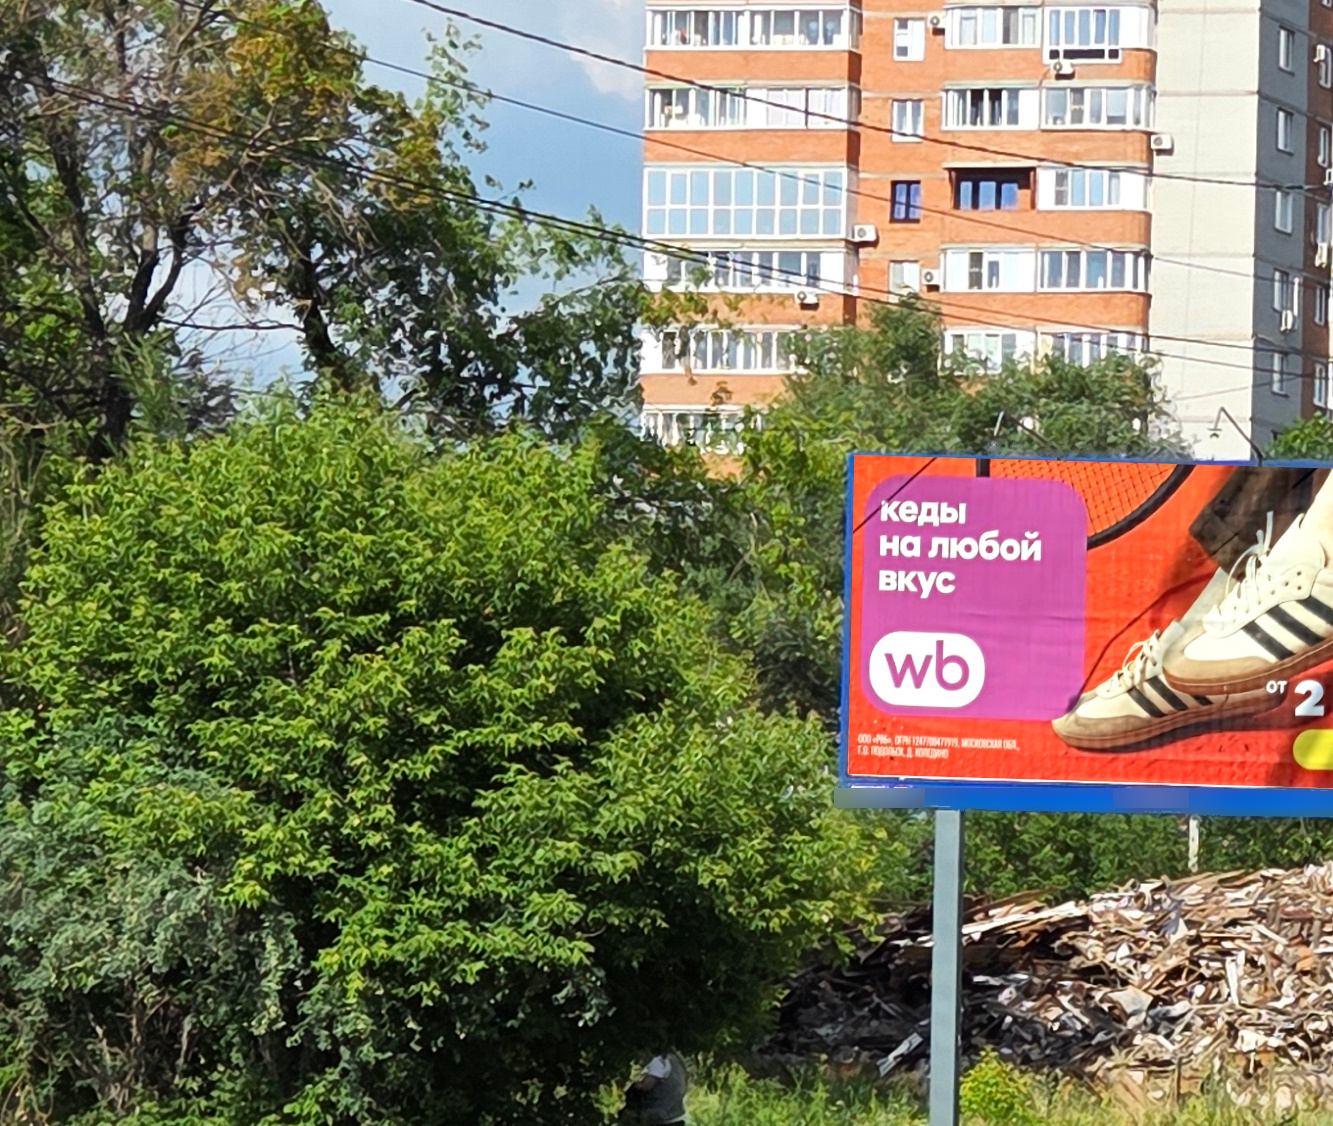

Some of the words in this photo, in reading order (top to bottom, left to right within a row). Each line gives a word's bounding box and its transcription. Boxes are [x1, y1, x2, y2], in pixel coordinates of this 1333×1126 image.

[880, 500, 967, 527] кеды
[879, 535, 921, 557] на
[928, 530, 1042, 561] любой
[878, 570, 956, 599] вкус
[884, 640, 970, 691] wb
[1265, 680, 1287, 694] от
